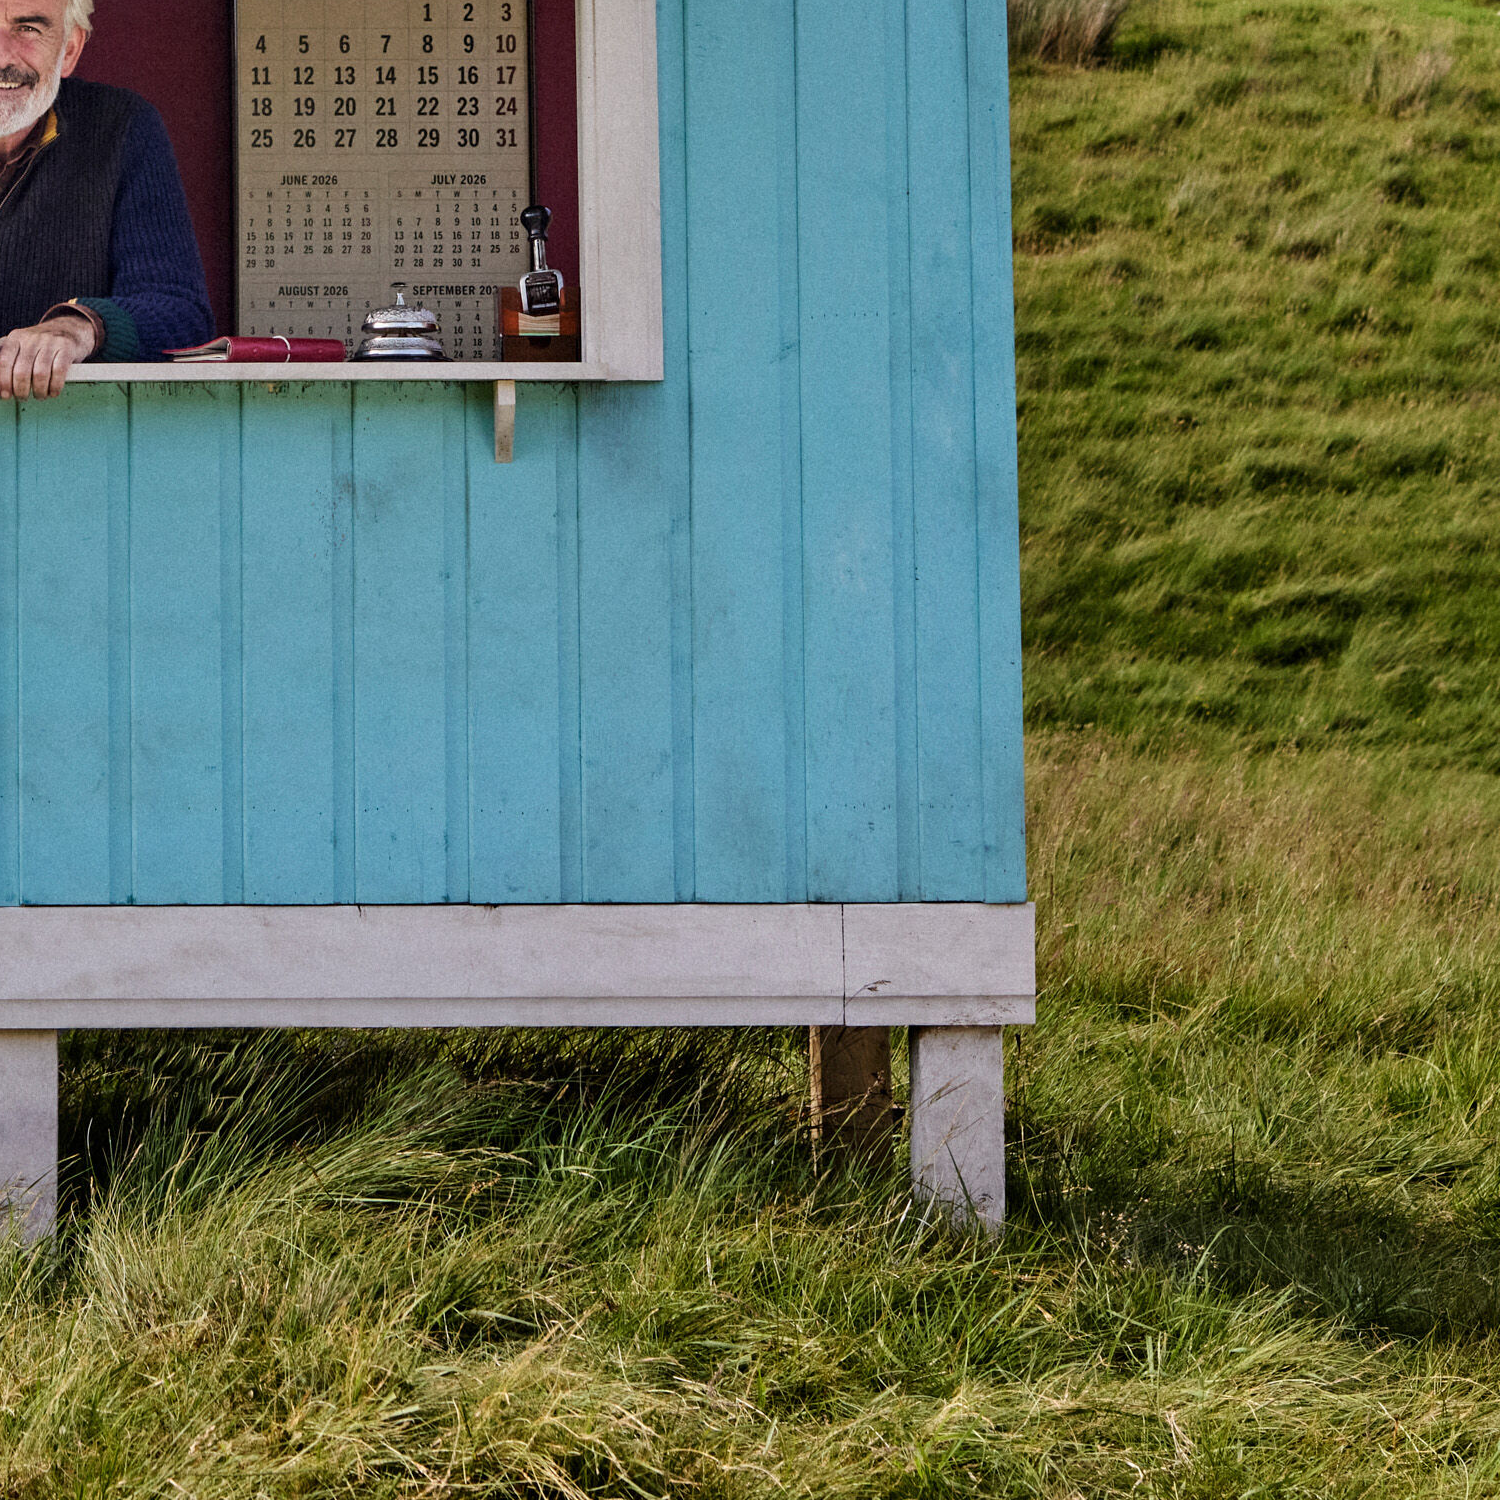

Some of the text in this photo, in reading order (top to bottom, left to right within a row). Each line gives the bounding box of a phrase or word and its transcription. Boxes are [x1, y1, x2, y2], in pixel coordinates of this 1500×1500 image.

[424, 3, 511, 21] 1 2 3
[256, 34, 516, 53] 4 5 6 7 8 9 10
[252, 66, 516, 85] 11 12 13 14 15 16 17
[252, 97, 517, 116] 18 19 20 21 22 23 24
[252, 128, 517, 148] 25 26 27 28 29 30 31
[281, 175, 337, 185] JUNE 2026
[431, 175, 486, 185] JULY 2026
[267, 204, 369, 213] 1 2 3 4 5 6
[436, 203, 517, 213] 1 2 3 4 5
[250, 218, 371, 227] 7 8 9 10 11 12 13
[397, 217, 519, 226] 6 7 8 9 10 11 12
[247, 231, 371, 241] 15 16 17 18 19 20
[395, 231, 519, 240] 13 14 15 16 17 18 19
[247, 245, 371, 255] 22 23 24 25 26 27 28
[395, 244, 520, 254] 20 21 22 23 24 25 26
[246, 259, 275, 268] 29 30
[394, 258, 480, 267] 27 28 29 30 31
[279, 286, 348, 296] AUGUST 2026
[413, 285, 499, 295] SEPTEMBER 202
[347, 314, 352, 322] 1
[457, 313, 480, 322] 3 4
[251, 326, 352, 335] 3 5 6 7 8
[454, 326, 482, 334] 10 11
[344, 339, 353, 347] 15
[454, 338, 463, 347] 17
[474, 338, 482, 346] 18
[453, 350, 482, 359] 24 25
